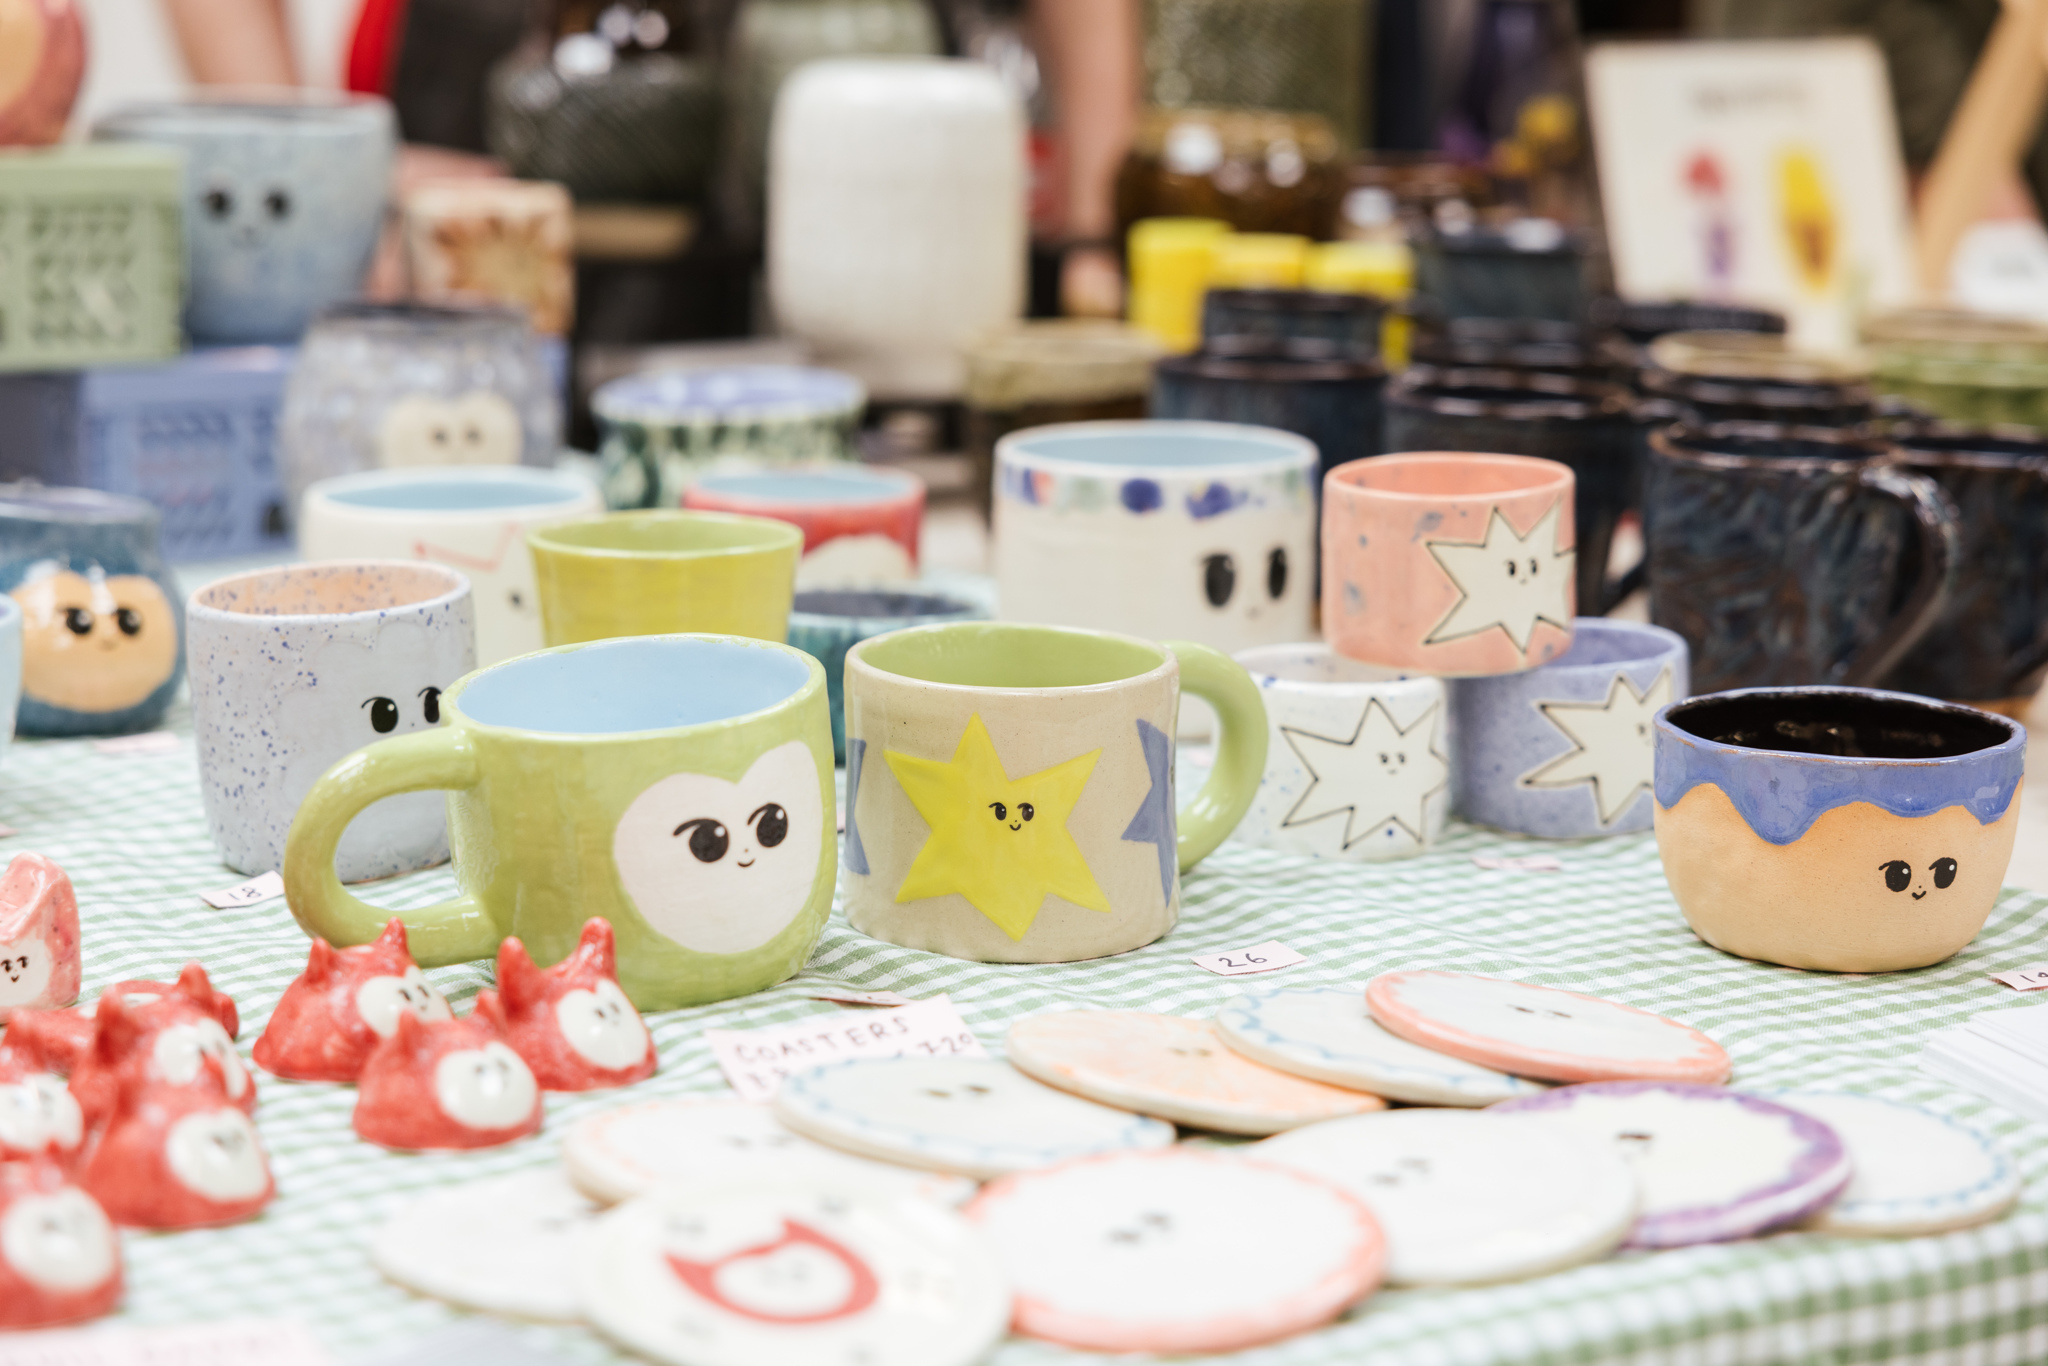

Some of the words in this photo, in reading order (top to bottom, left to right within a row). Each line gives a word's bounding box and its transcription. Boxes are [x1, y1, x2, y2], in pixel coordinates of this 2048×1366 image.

[227, 886, 262, 901] 18
[1218, 952, 1268, 968] 26
[733, 1015, 909, 1063] COASTERS
